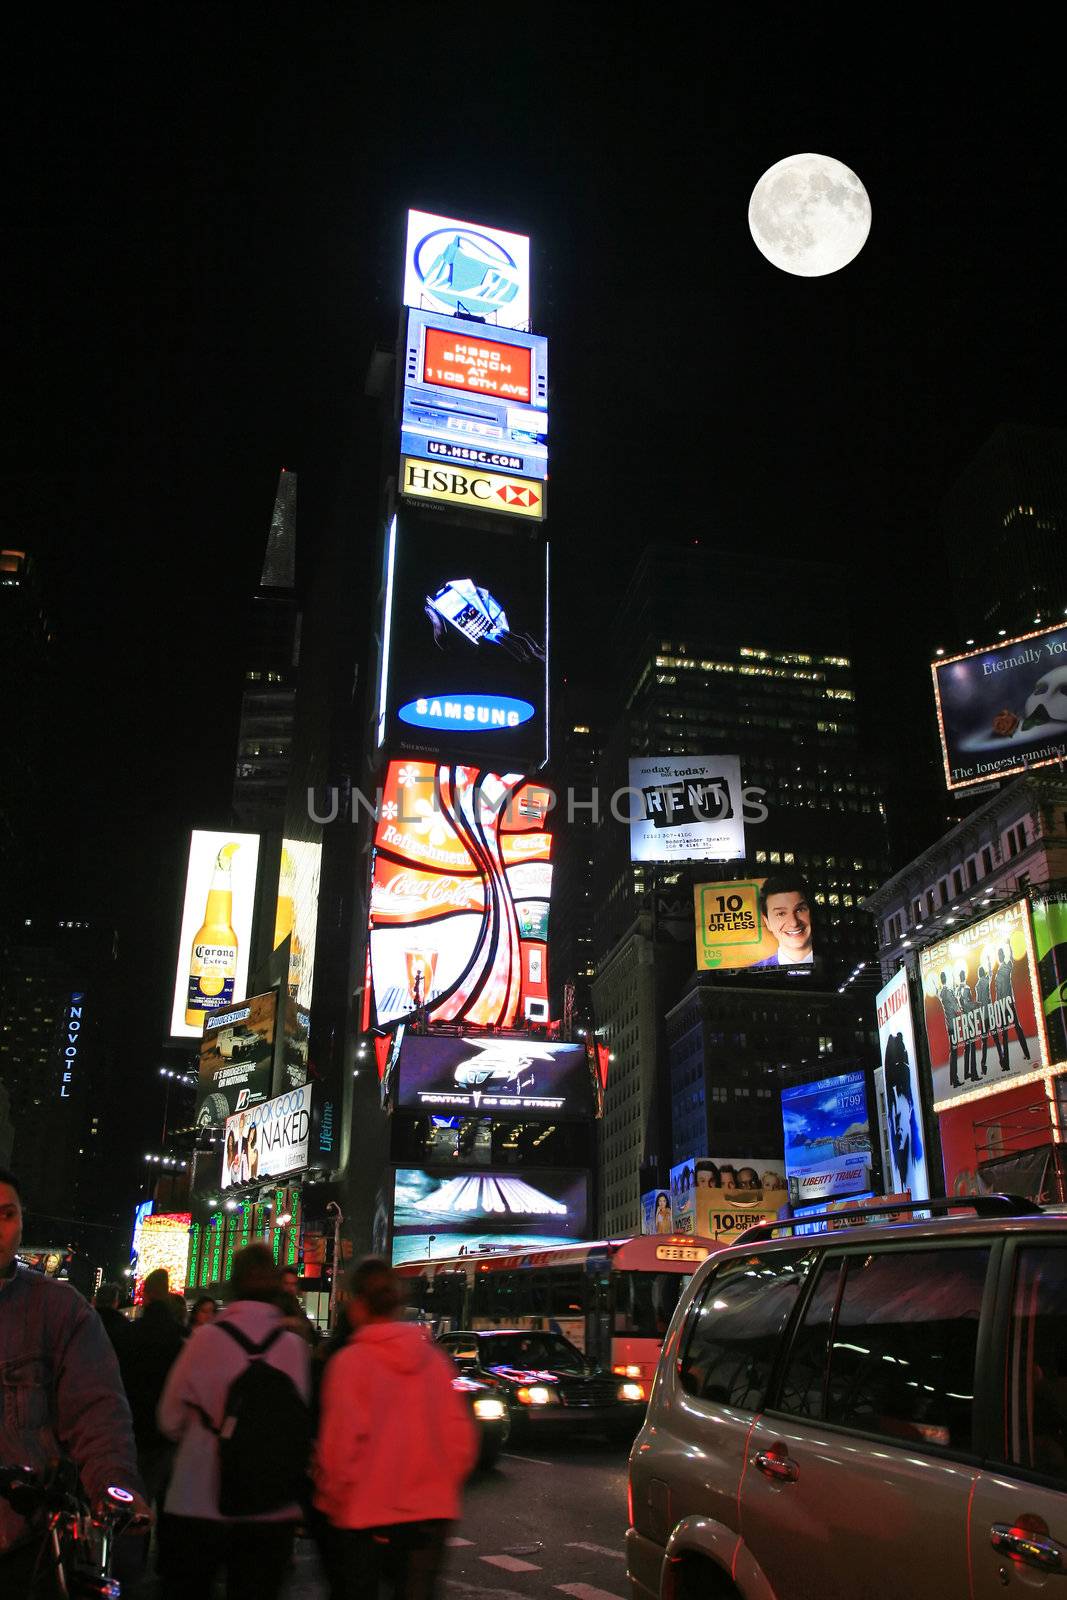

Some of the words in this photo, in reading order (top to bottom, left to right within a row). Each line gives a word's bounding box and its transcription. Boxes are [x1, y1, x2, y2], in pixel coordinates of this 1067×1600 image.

[443, 351, 512, 373] BRANCH
[467, 367, 488, 378] AT
[500, 383, 529, 397] AVE
[429, 442, 521, 469] US.HSBC.COM
[406, 465, 492, 500] HSBC
[983, 649, 1042, 676] Eternally
[416, 698, 520, 727] SAMSUNG
[652, 766, 671, 774] day
[674, 767, 709, 777] today.
[952, 767, 974, 780] The
[976, 744, 1066, 775] longest-running
[646, 783, 722, 813] RENT
[716, 895, 744, 913] 10
[708, 923, 725, 932] OR
[727, 921, 756, 930] LESS
[710, 911, 753, 923] ITEMS
[195, 945, 234, 958] Corona
[203, 957, 228, 965] Extra
[704, 949, 722, 958] tbs
[878, 983, 908, 1028] RAMBO
[951, 1006, 987, 1045] JERSEY
[987, 995, 1015, 1030] BOYS
[60, 1006, 83, 1097] NOVOTEL
[276, 1089, 305, 1118] GOOD
[421, 1095, 470, 1104] PONTIAC
[261, 1110, 310, 1155] NAKED
[320, 1101, 334, 1152] Lifetime
[802, 1173, 834, 1187] LIBERTY
[835, 1169, 862, 1181] TRAVEL
[713, 1214, 735, 1230] 10
[735, 1214, 766, 1223] ITEMS
